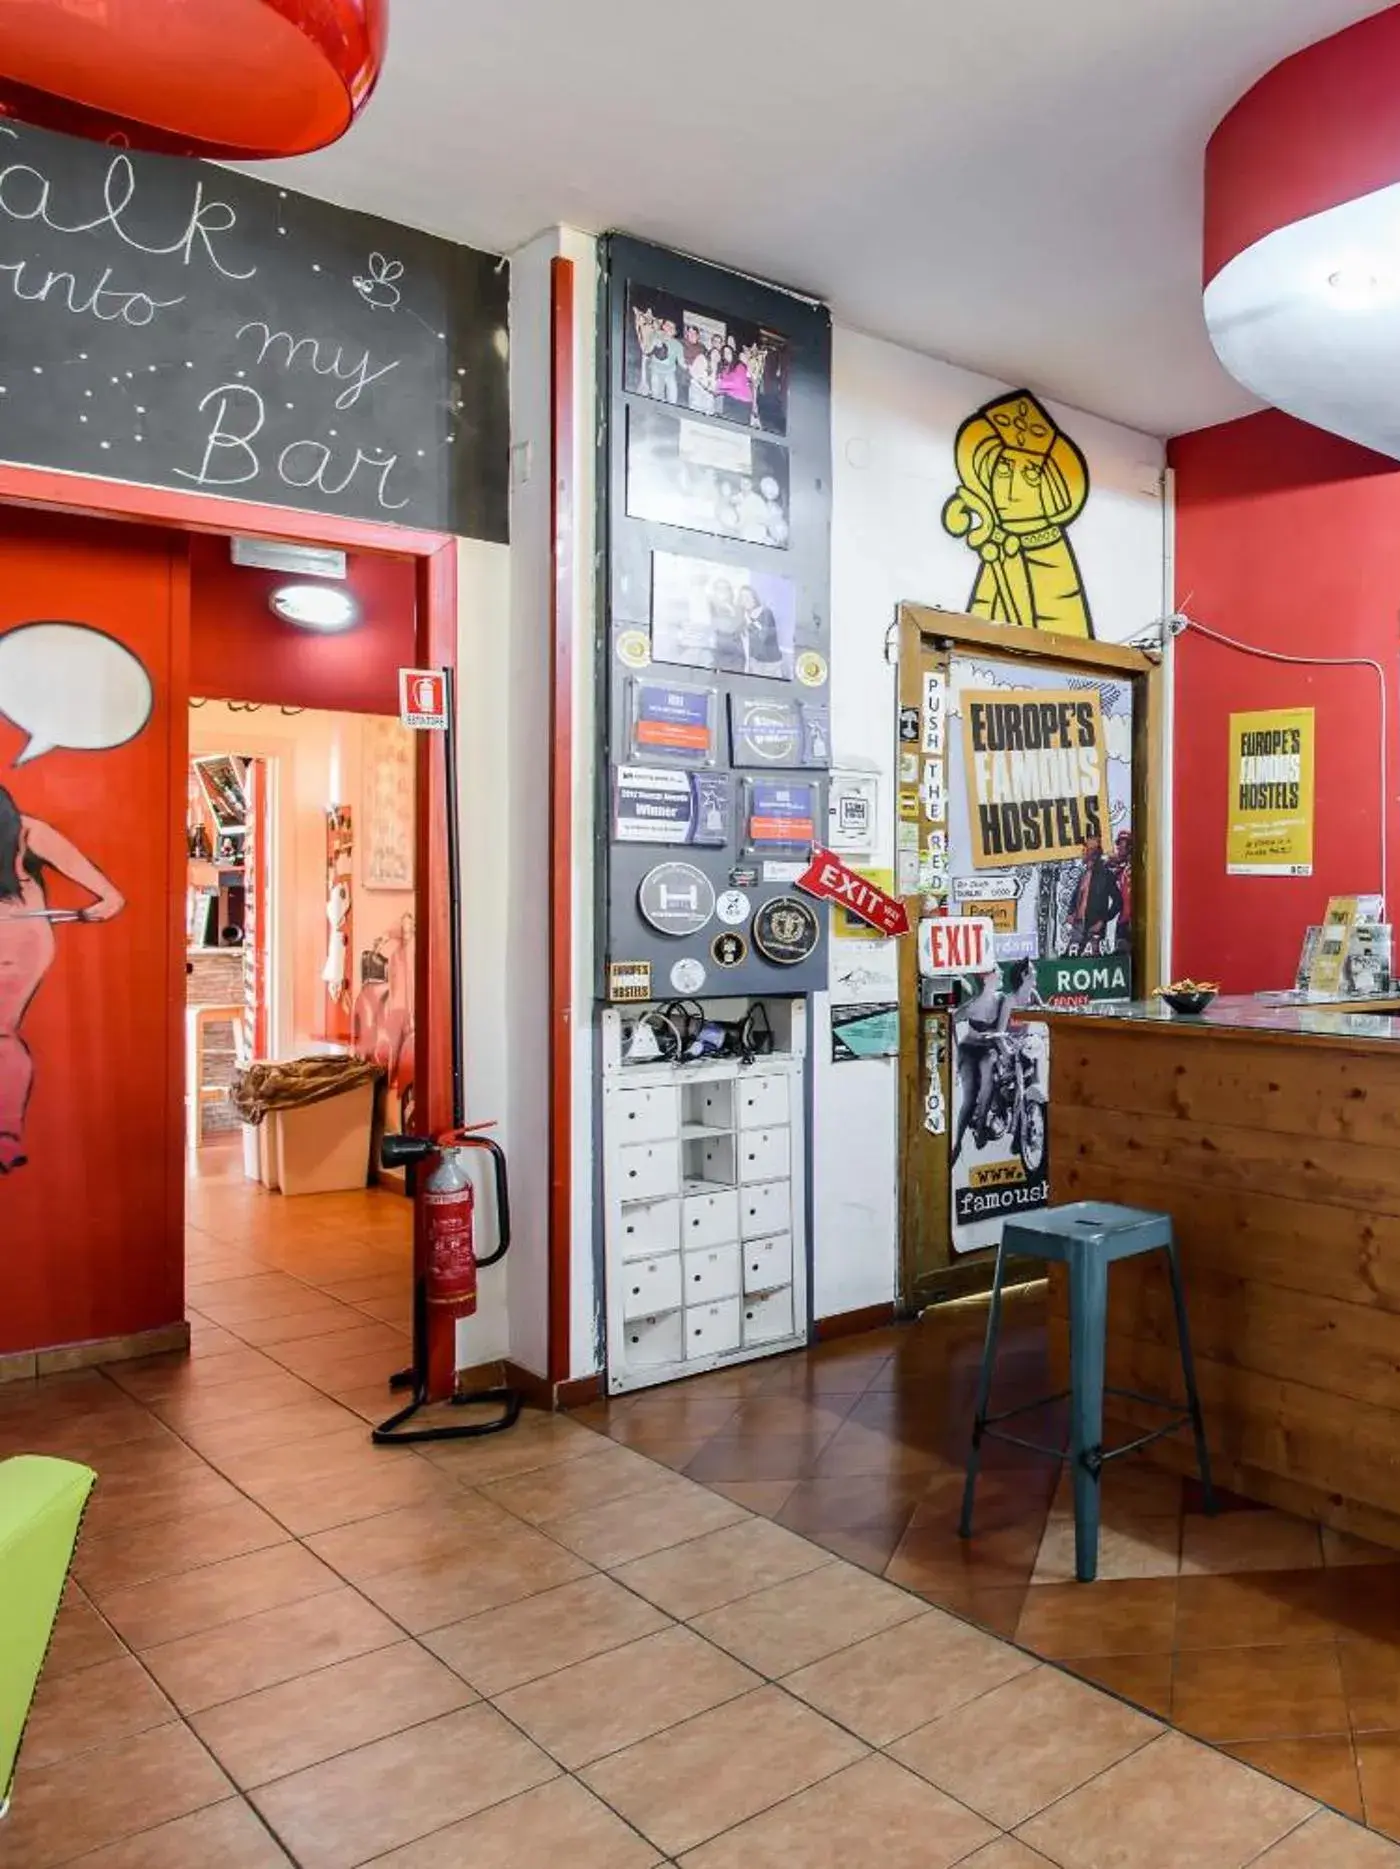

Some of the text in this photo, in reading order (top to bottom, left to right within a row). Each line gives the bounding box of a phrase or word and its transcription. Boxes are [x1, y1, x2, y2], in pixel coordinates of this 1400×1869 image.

[0, 130, 256, 279] alk
[236, 322, 399, 410] my
[172, 384, 410, 509] Bar
[970, 701, 1096, 752] EUROPE'S
[1240, 728, 1301, 757] EUROPE'S
[927, 678, 942, 890] PUSH THE RED
[974, 747, 1100, 805] FAMOUS
[1239, 781, 1300, 811] HOSTELS
[635, 802, 679, 818] Winner
[978, 794, 1100, 857] HOSTELS
[819, 864, 885, 914] EXIT
[930, 923, 984, 969] EXIT
[1056, 967, 1127, 993] ROMA
[977, 1166, 1024, 1184] www.
